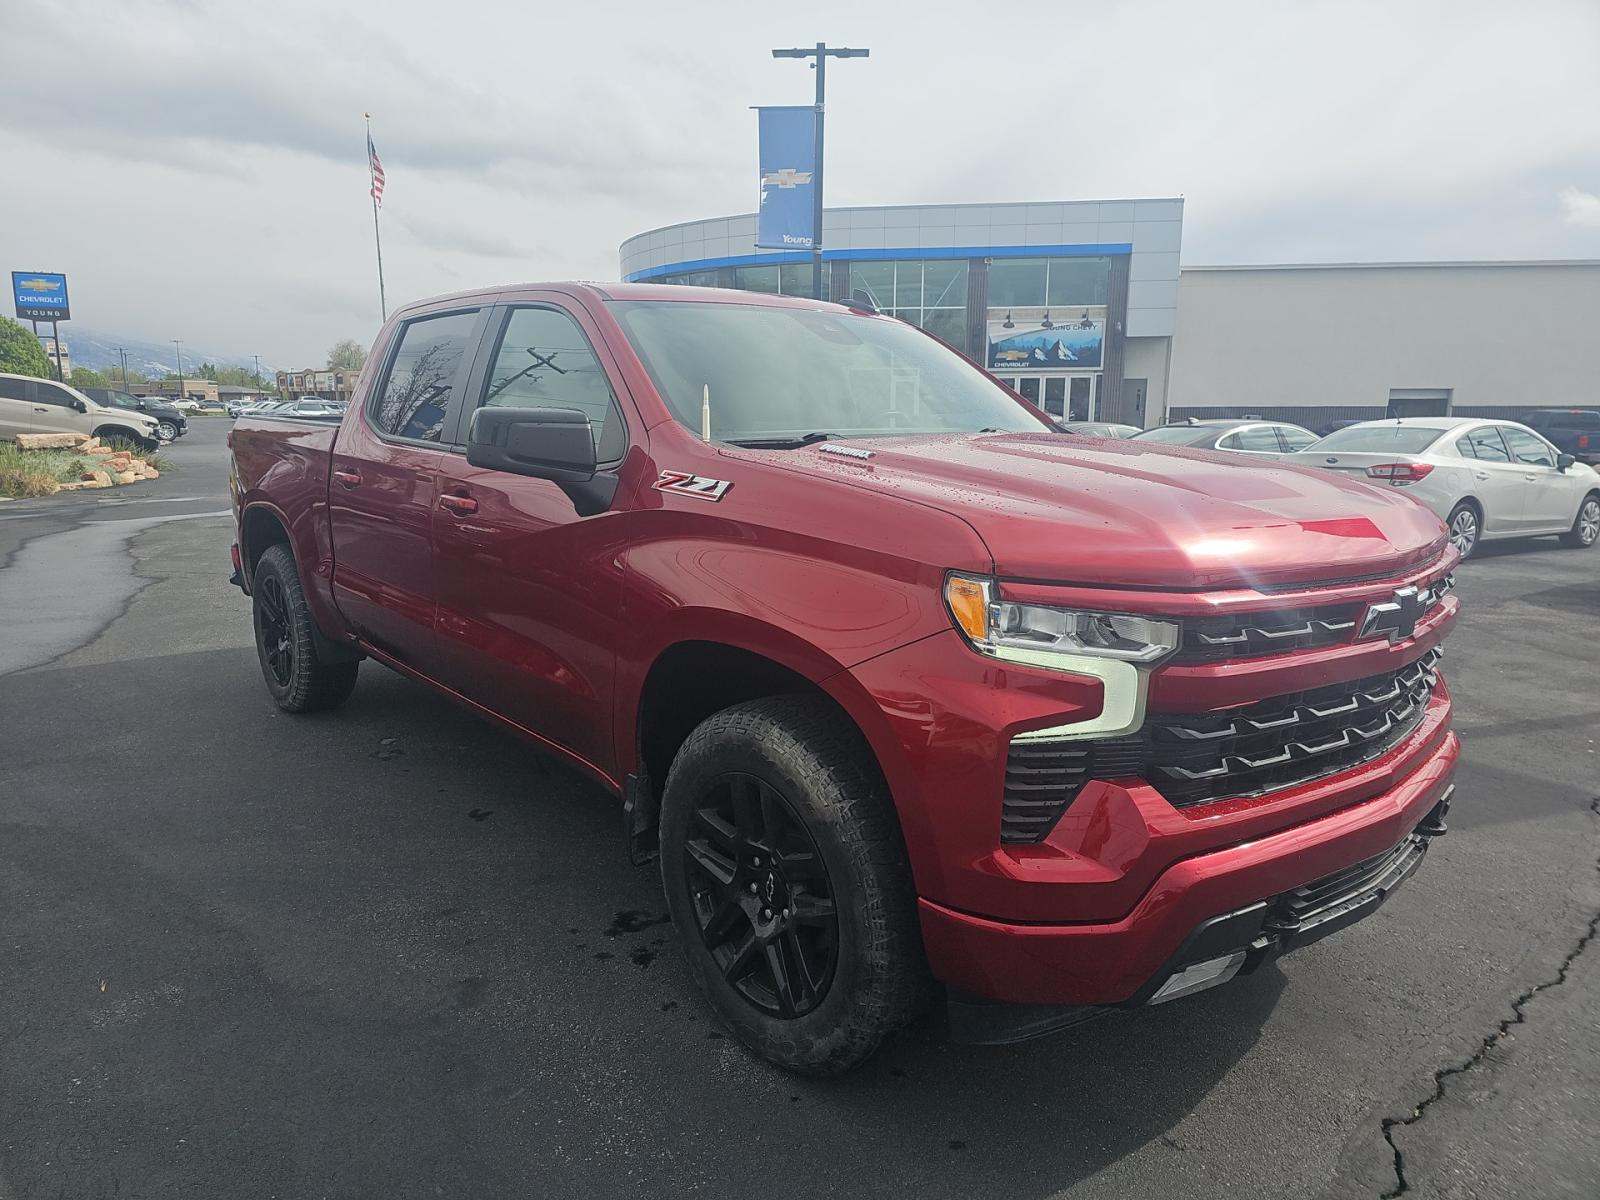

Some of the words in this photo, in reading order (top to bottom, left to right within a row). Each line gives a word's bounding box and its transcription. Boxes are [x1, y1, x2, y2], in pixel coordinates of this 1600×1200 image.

[783, 234, 812, 246] Young
[19, 295, 63, 303] CHEVROLET
[651, 469, 731, 502] Z71
